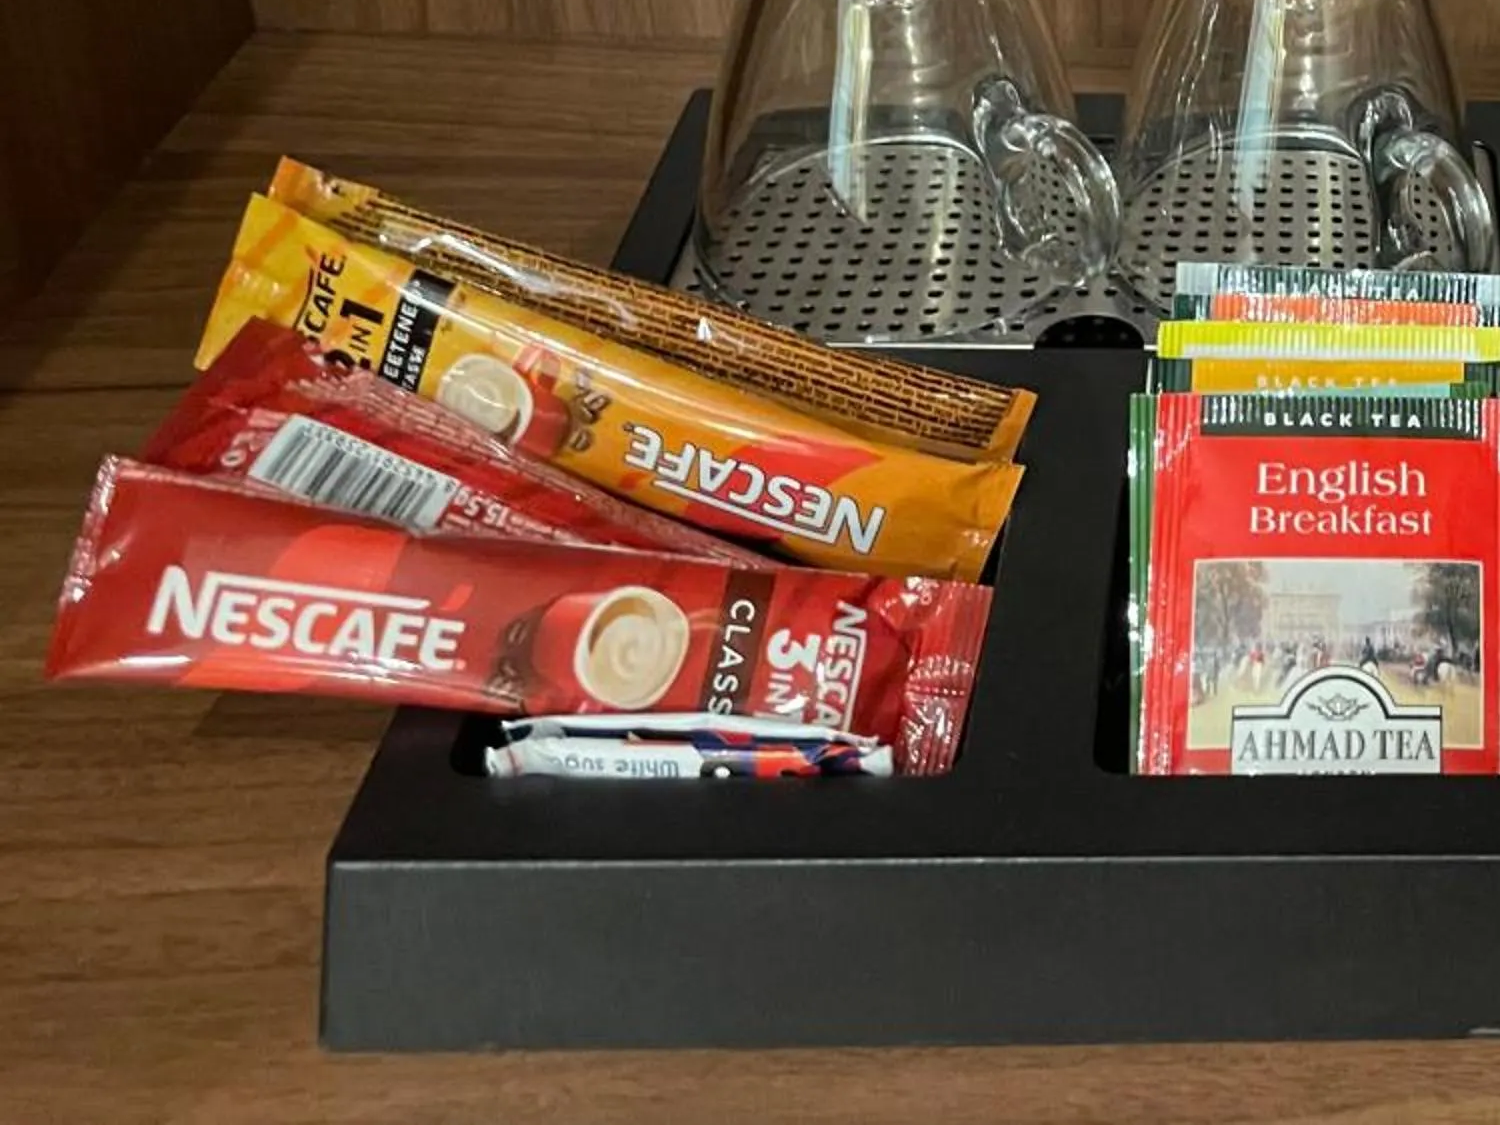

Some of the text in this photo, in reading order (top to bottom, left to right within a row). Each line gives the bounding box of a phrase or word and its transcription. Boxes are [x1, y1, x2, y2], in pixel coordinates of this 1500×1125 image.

[339, 298, 385, 325] 1
[349, 325, 374, 353] IN
[1264, 412, 1422, 428] BLACK TEA
[1256, 460, 1427, 503] English
[1250, 503, 1433, 536] Breakfast
[767, 628, 821, 672] 3
[1239, 729, 1435, 761] AHMAD TEA
